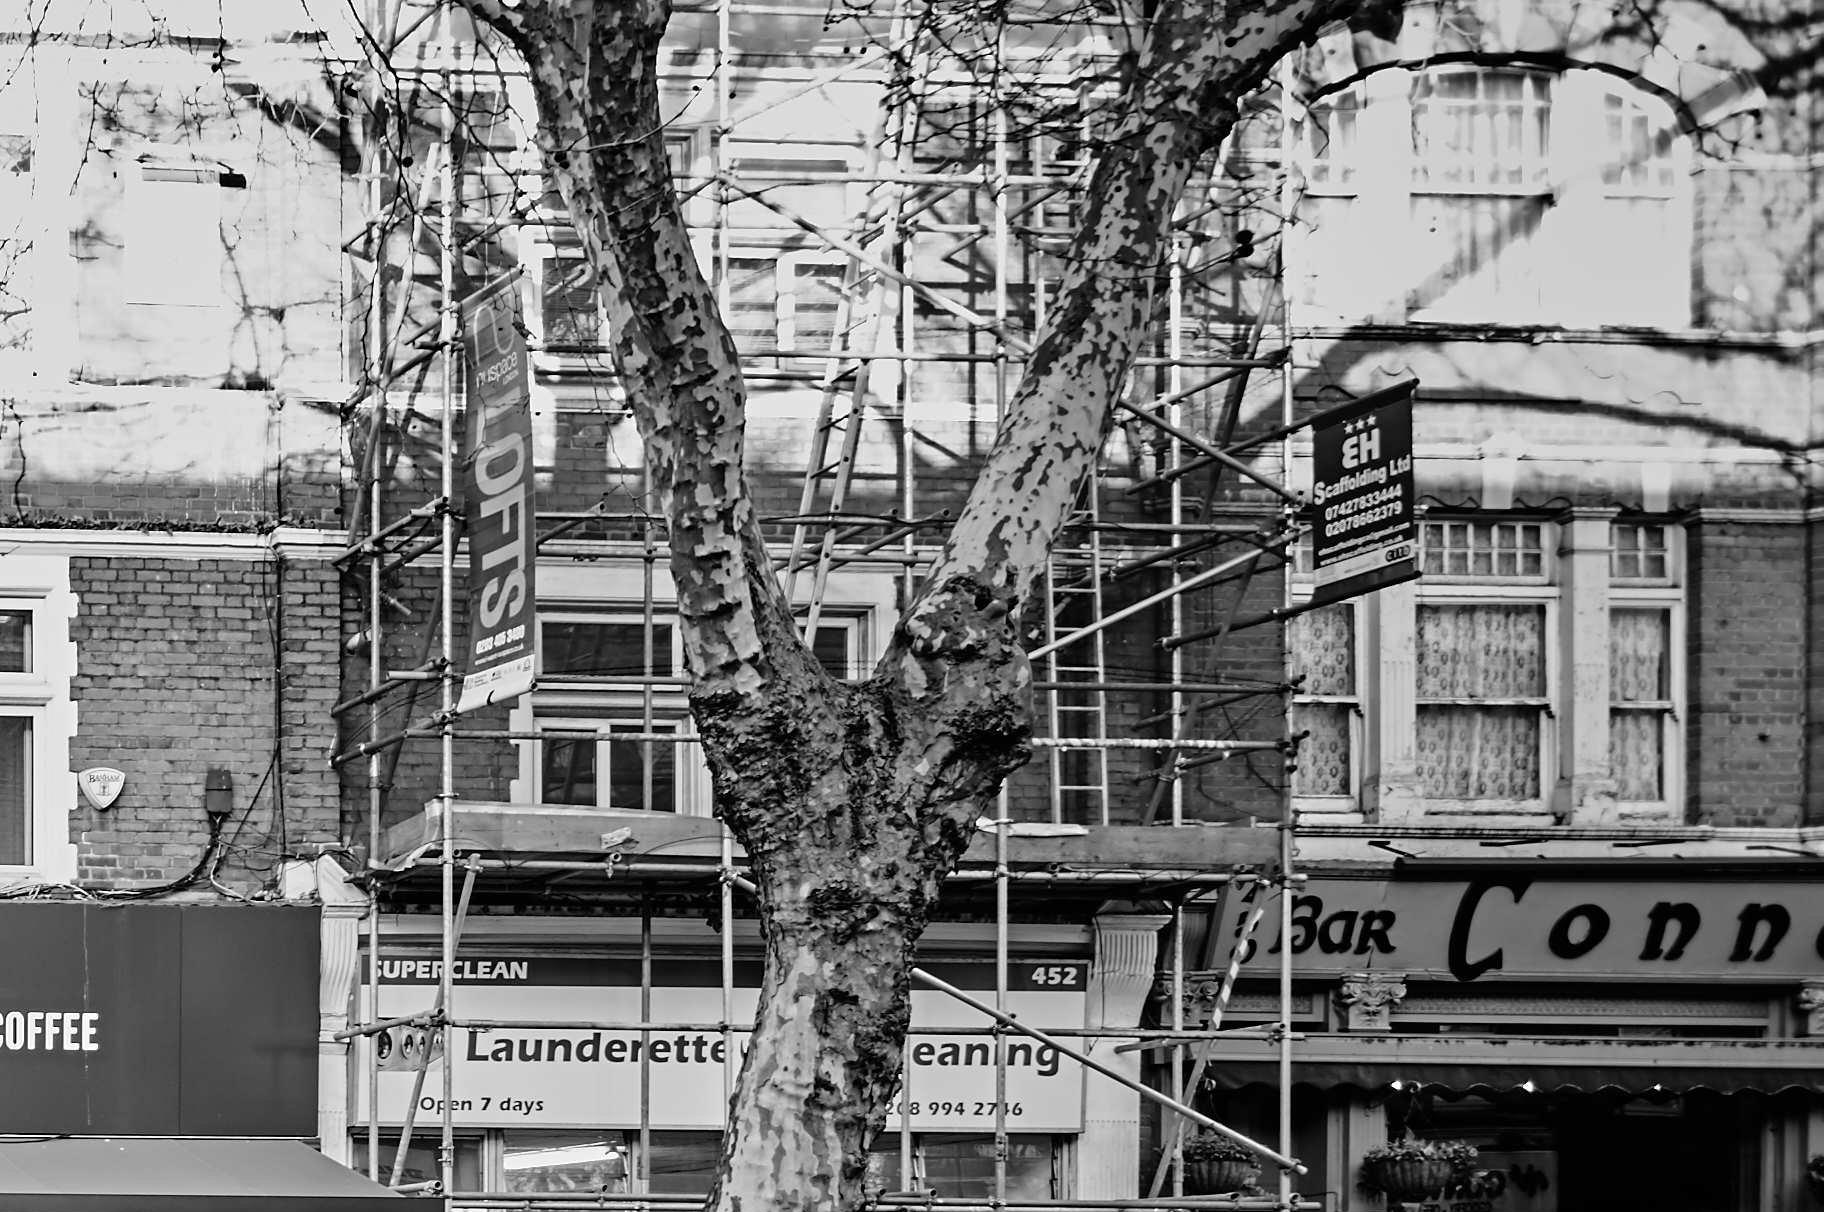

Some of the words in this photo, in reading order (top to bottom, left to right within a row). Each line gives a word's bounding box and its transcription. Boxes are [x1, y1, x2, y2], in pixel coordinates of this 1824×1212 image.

[1342, 427, 1380, 469] EH
[1314, 466, 1387, 505] Scaffolding
[1389, 454, 1410, 476] Ltd
[474, 386, 527, 628] LOFTS
[1449, 877, 1824, 982] Conn
[1031, 967, 1077, 985] 452
[466, 1030, 726, 1064] Launderette
[419, 1096, 472, 1115] Open
[480, 1096, 492, 1111] 7
[499, 1096, 544, 1116] days
[884, 1101, 920, 1116] 208
[928, 1102, 965, 1116] 994
